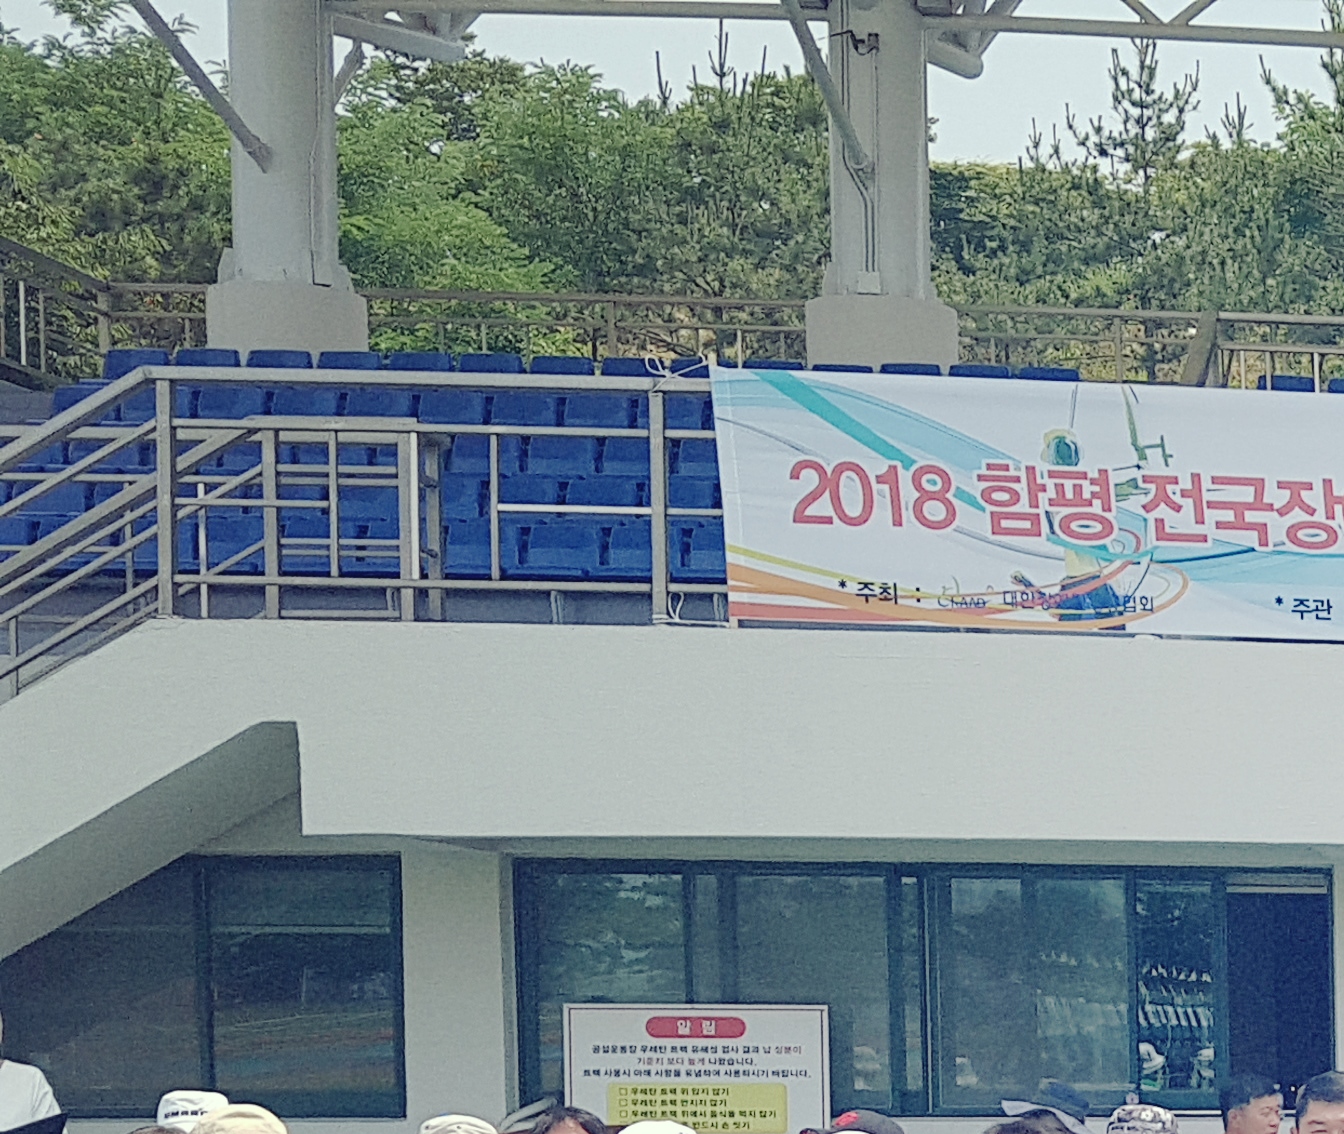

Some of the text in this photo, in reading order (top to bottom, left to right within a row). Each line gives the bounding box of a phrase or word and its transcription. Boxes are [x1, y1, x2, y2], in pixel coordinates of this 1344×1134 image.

[789, 459, 957, 531] 2018
[976, 462, 1116, 543] 함평
[856, 582, 898, 605] 주최
[1291, 598, 1333, 621] 주관
